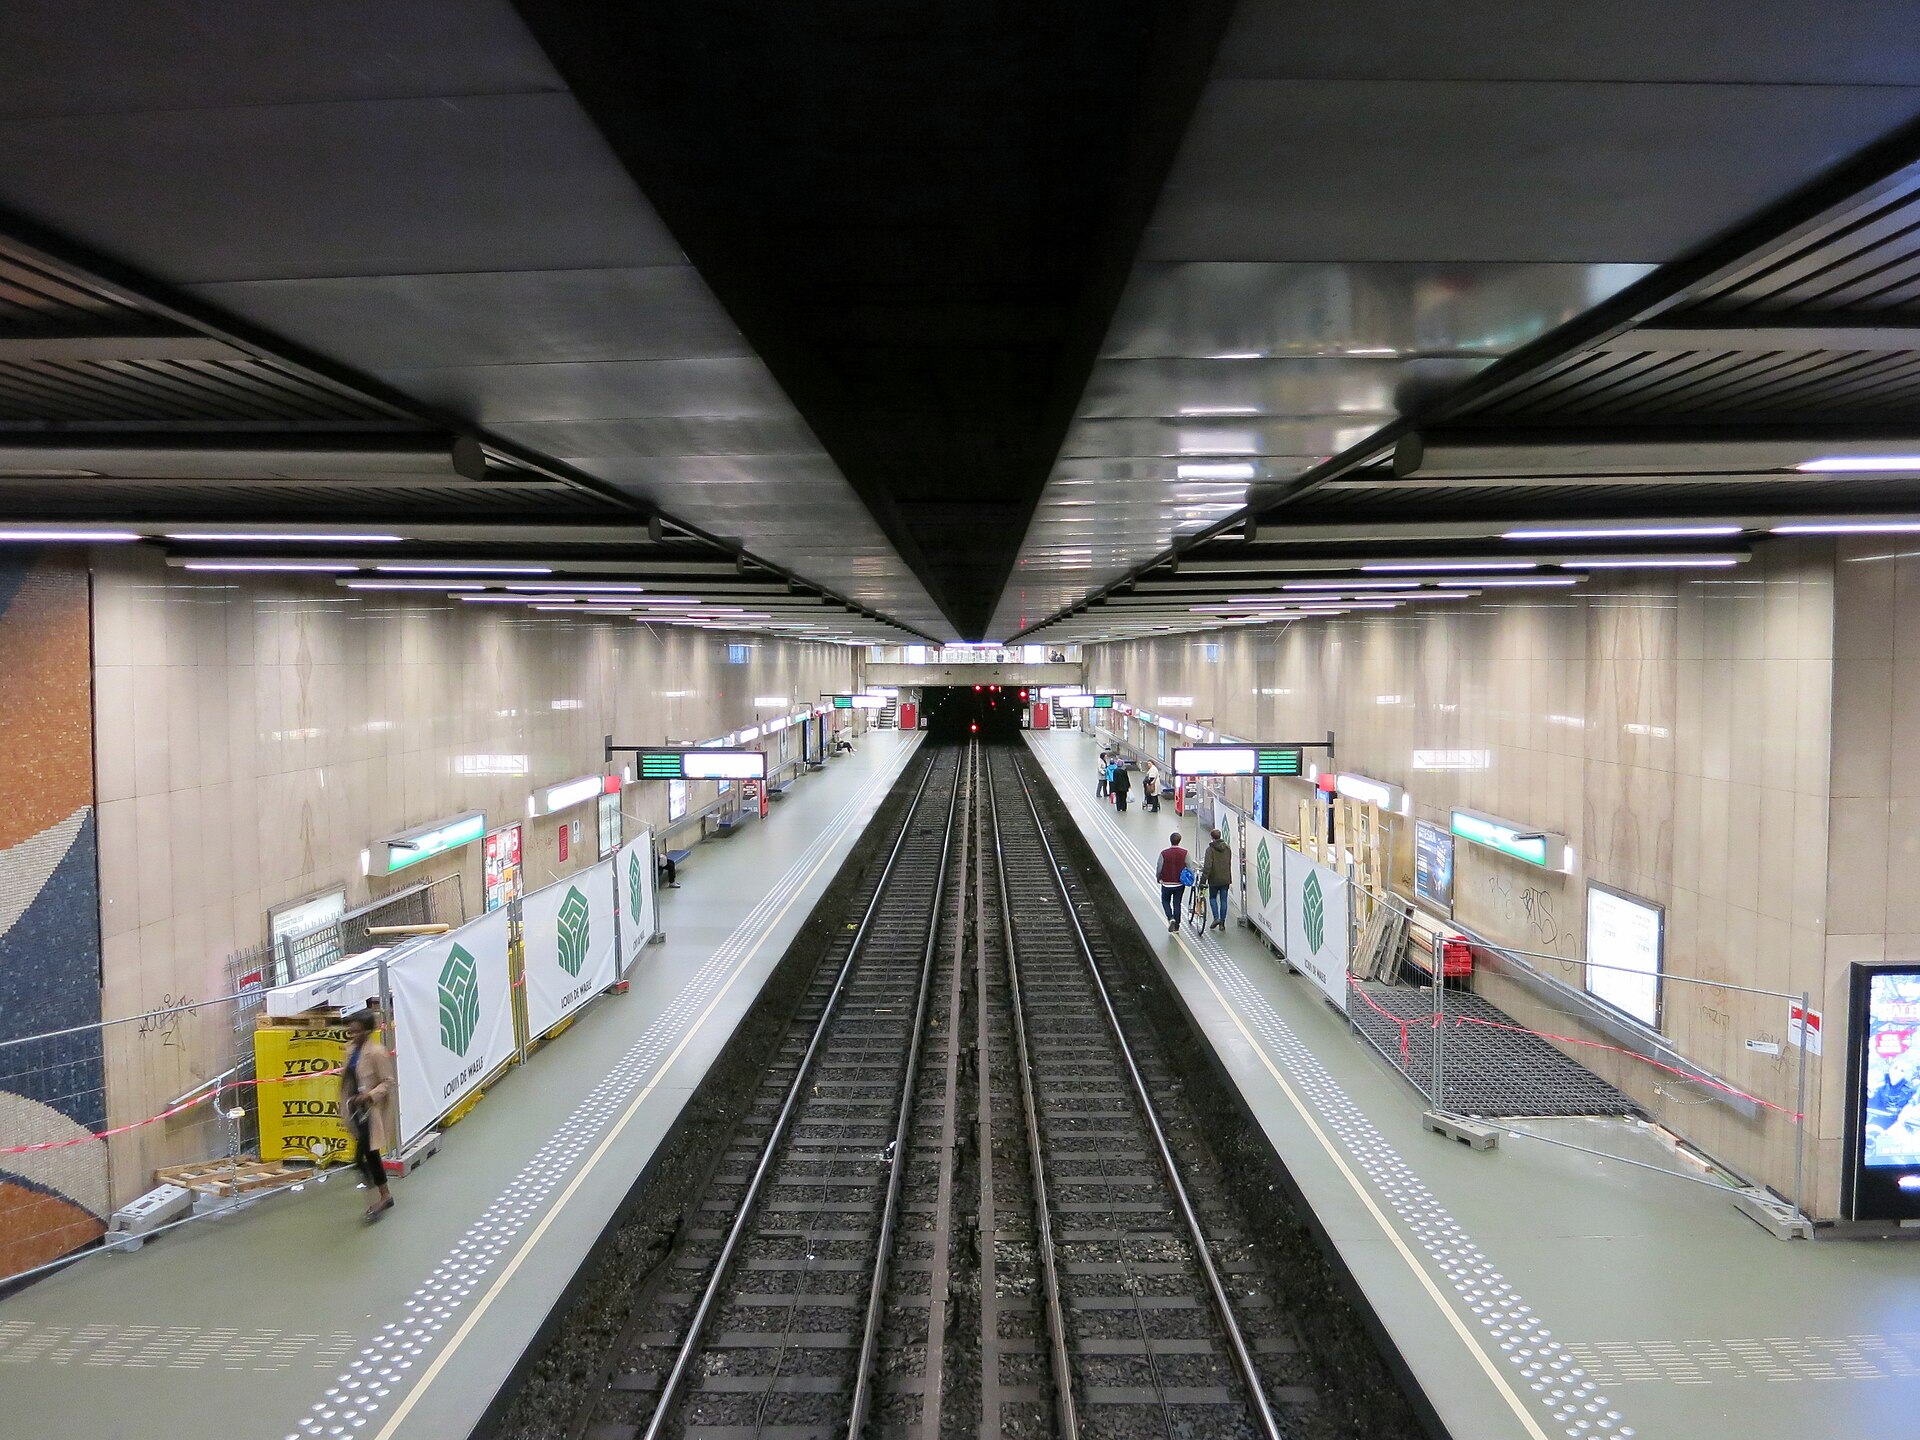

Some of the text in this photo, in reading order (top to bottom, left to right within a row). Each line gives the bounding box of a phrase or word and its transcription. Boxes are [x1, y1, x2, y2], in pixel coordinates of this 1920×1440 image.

[443, 1056, 484, 1099] LOUIS DE WAELE
[282, 1136, 348, 1151] YTONG
